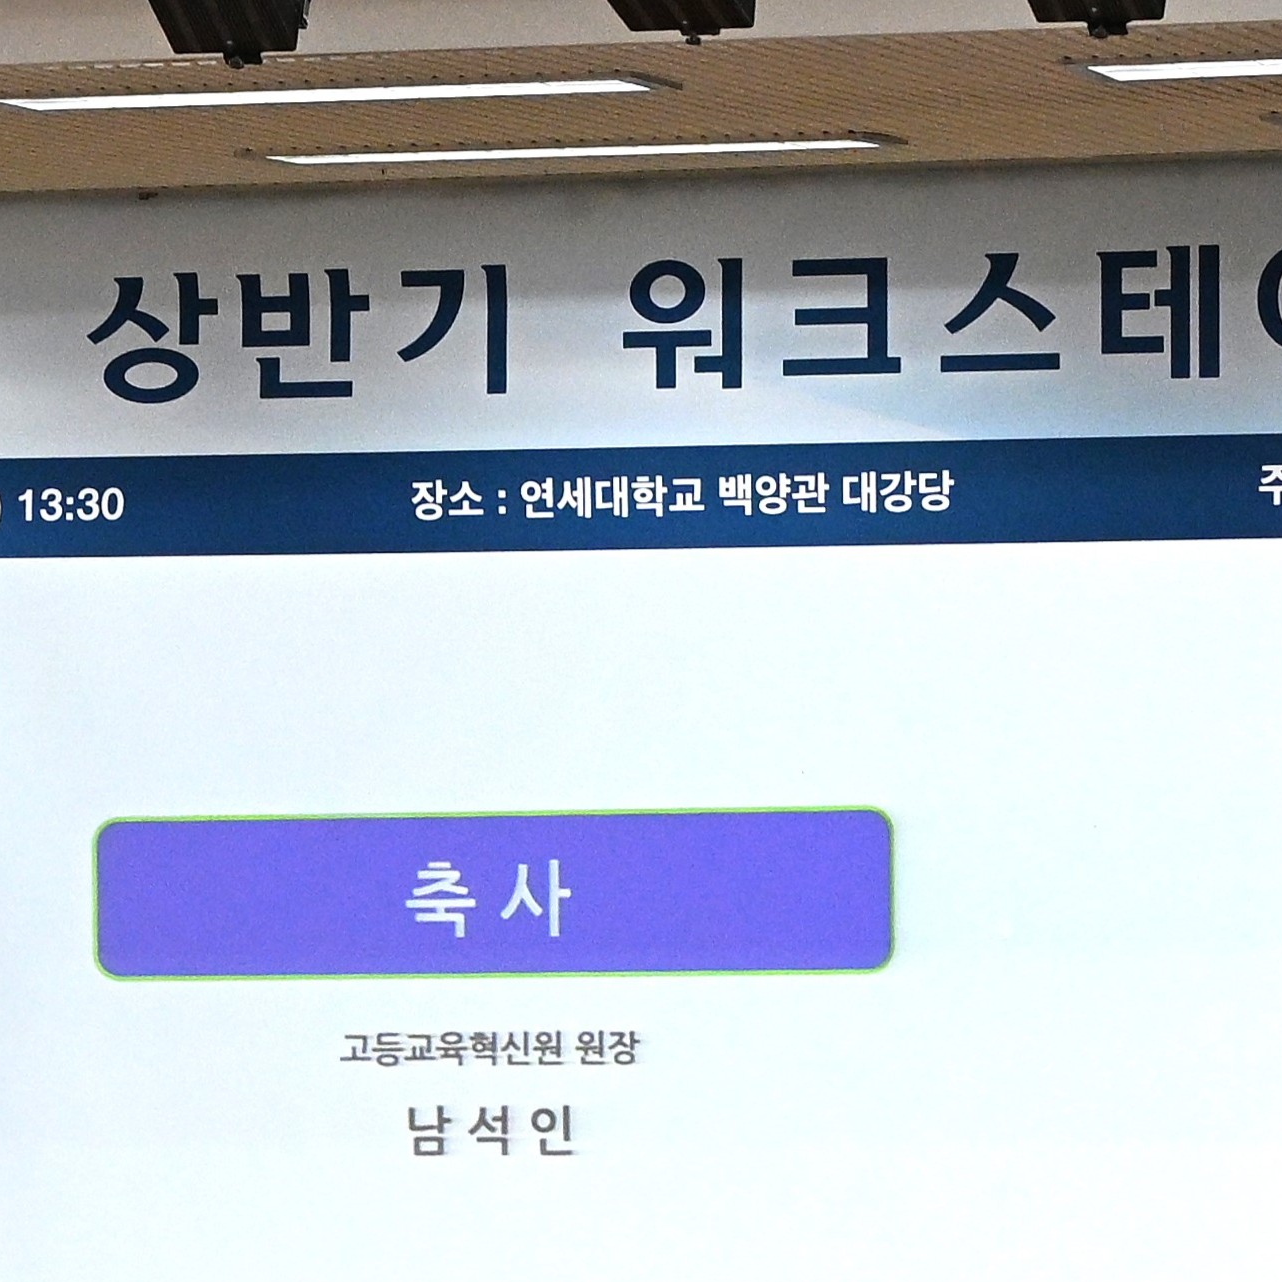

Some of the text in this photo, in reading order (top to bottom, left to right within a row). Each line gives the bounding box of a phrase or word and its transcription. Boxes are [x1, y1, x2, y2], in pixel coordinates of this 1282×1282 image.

[86, 263, 508, 404] 상반기
[18, 487, 125, 522] 13:30
[411, 479, 485, 521] 장소
[520, 474, 705, 519] 연세대학교
[718, 472, 830, 516] 백양관
[842, 469, 955, 514] 대강당
[339, 1029, 642, 1068] 고등교육혁신원 원장
